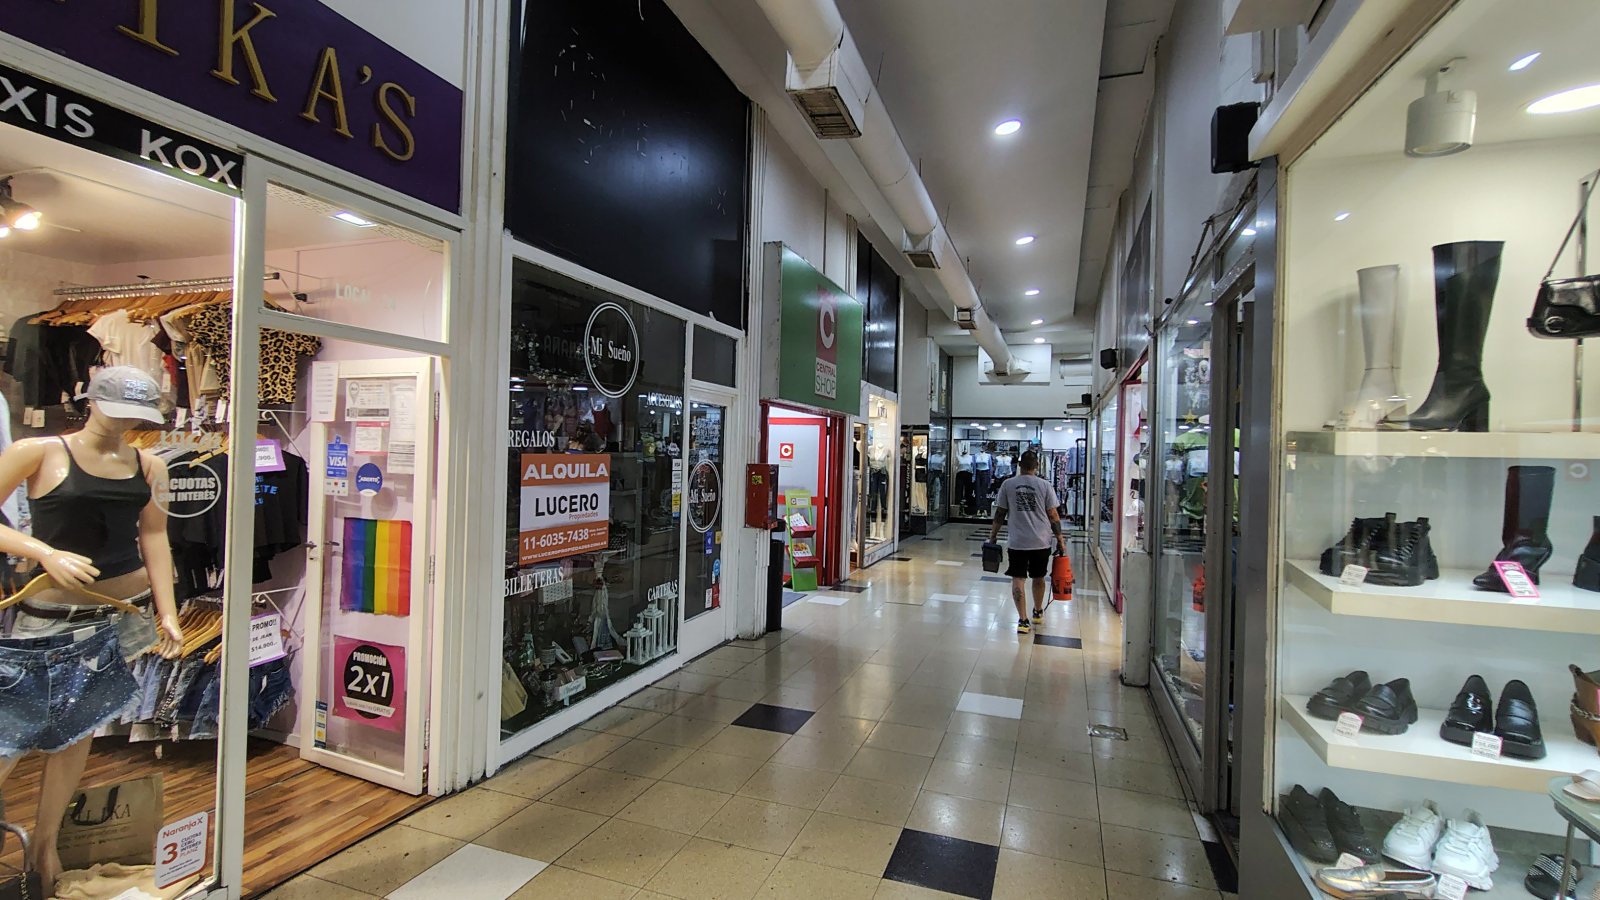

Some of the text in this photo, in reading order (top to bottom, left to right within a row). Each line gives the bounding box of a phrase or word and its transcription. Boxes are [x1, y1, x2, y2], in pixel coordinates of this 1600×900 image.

[139, 128, 238, 190] KOX
[590, 335, 603, 357] Mi
[608, 340, 632, 362] Sueño
[816, 361, 836, 378] CENTRAL
[815, 375, 836, 395] SHOP
[646, 391, 683, 409] ACCESORIOS
[508, 429, 556, 448] REGALOS
[328, 456, 347, 467] VISA
[523, 463, 608, 480] ALQUILA
[170, 477, 216, 490] CUOTAS
[177, 489, 215, 501] INTERÉS
[535, 493, 599, 517] LUCERO
[568, 511, 599, 520] Propiedades
[524, 528, 589, 551] 11-6035-7438
[504, 566, 564, 598] BILLETERAS
[647, 579, 678, 601] CARTERAS
[353, 651, 387, 666] PROMOCIÓN
[347, 665, 391, 698] 2x1
[163, 816, 203, 839] Naranja X
[180, 840, 202, 852] INTERÉS
[181, 832, 202, 843] CUOTAS
[181, 838, 196, 848] CERO
[161, 842, 178, 865] 3
